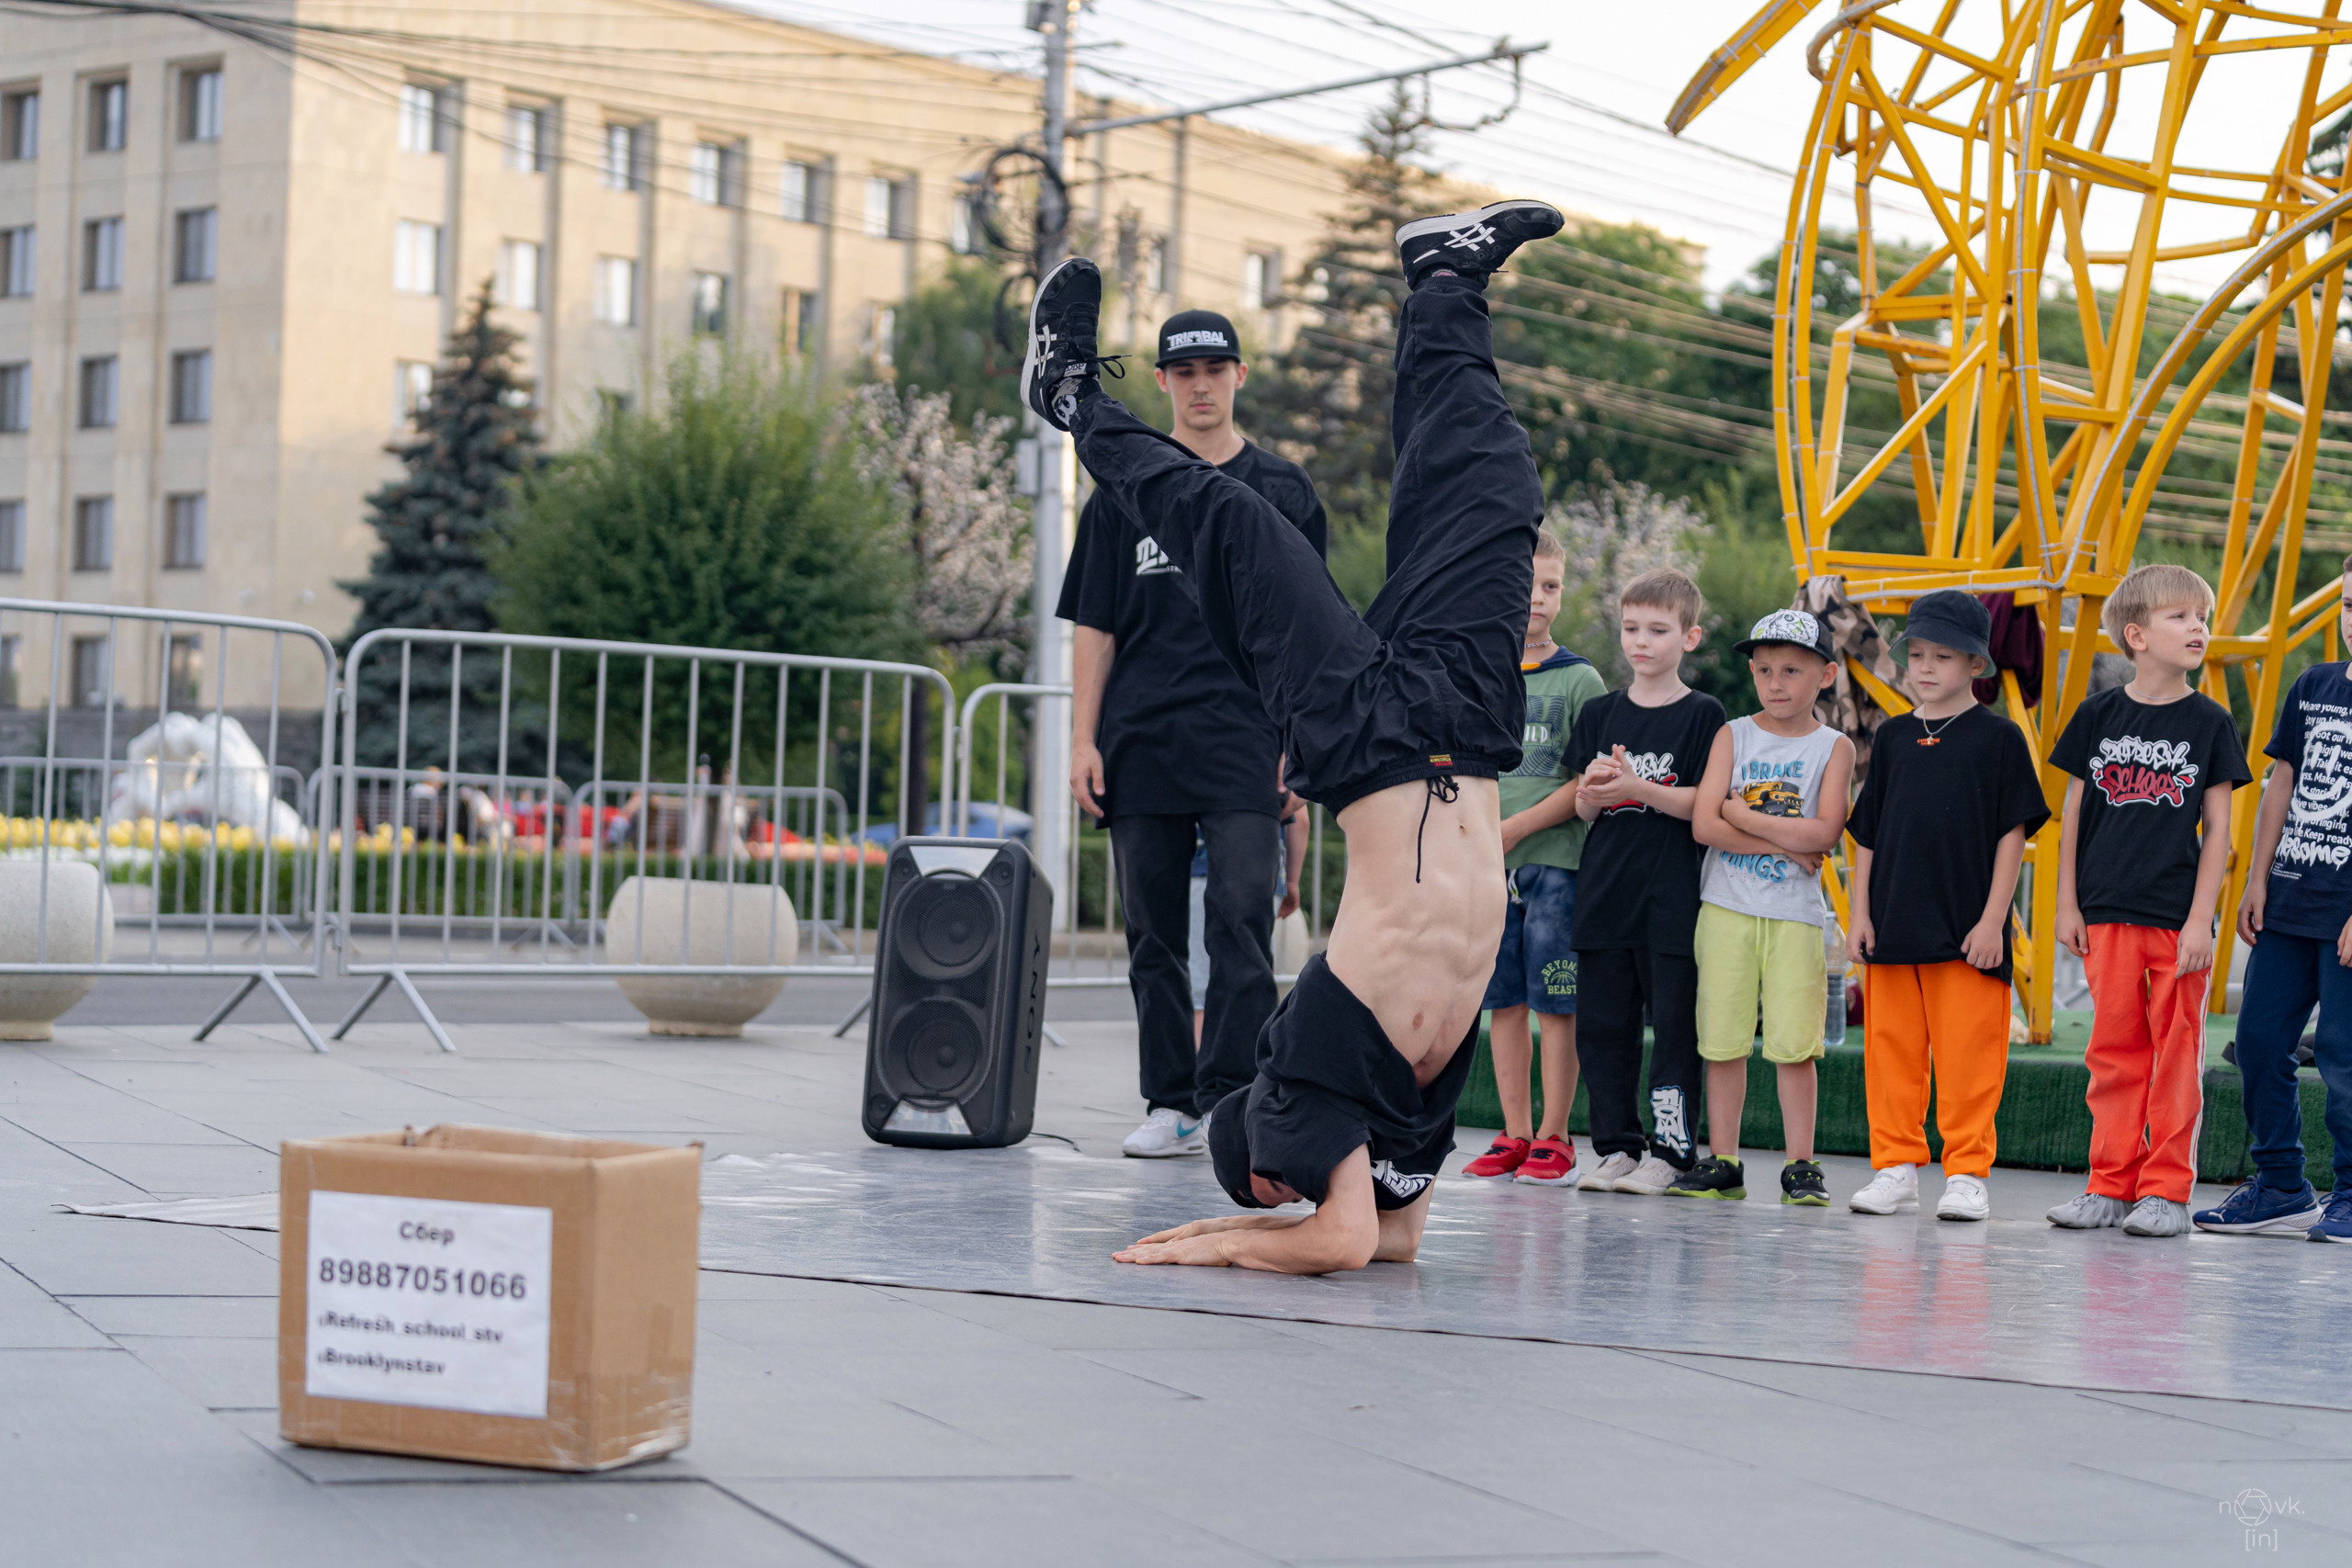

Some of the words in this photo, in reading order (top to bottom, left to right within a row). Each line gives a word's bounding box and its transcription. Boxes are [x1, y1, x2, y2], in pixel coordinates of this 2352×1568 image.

[2320, 704, 2348, 716] young,
[1524, 725, 1548, 743] ILD
[1742, 763, 1747, 781] I
[1749, 761, 1804, 780] BRAKE
[2304, 828, 2324, 842] Keep
[1547, 984, 1577, 995] BEAST
[399, 1220, 455, 1246] Сбер
[320, 1258, 526, 1300] 89887051066
